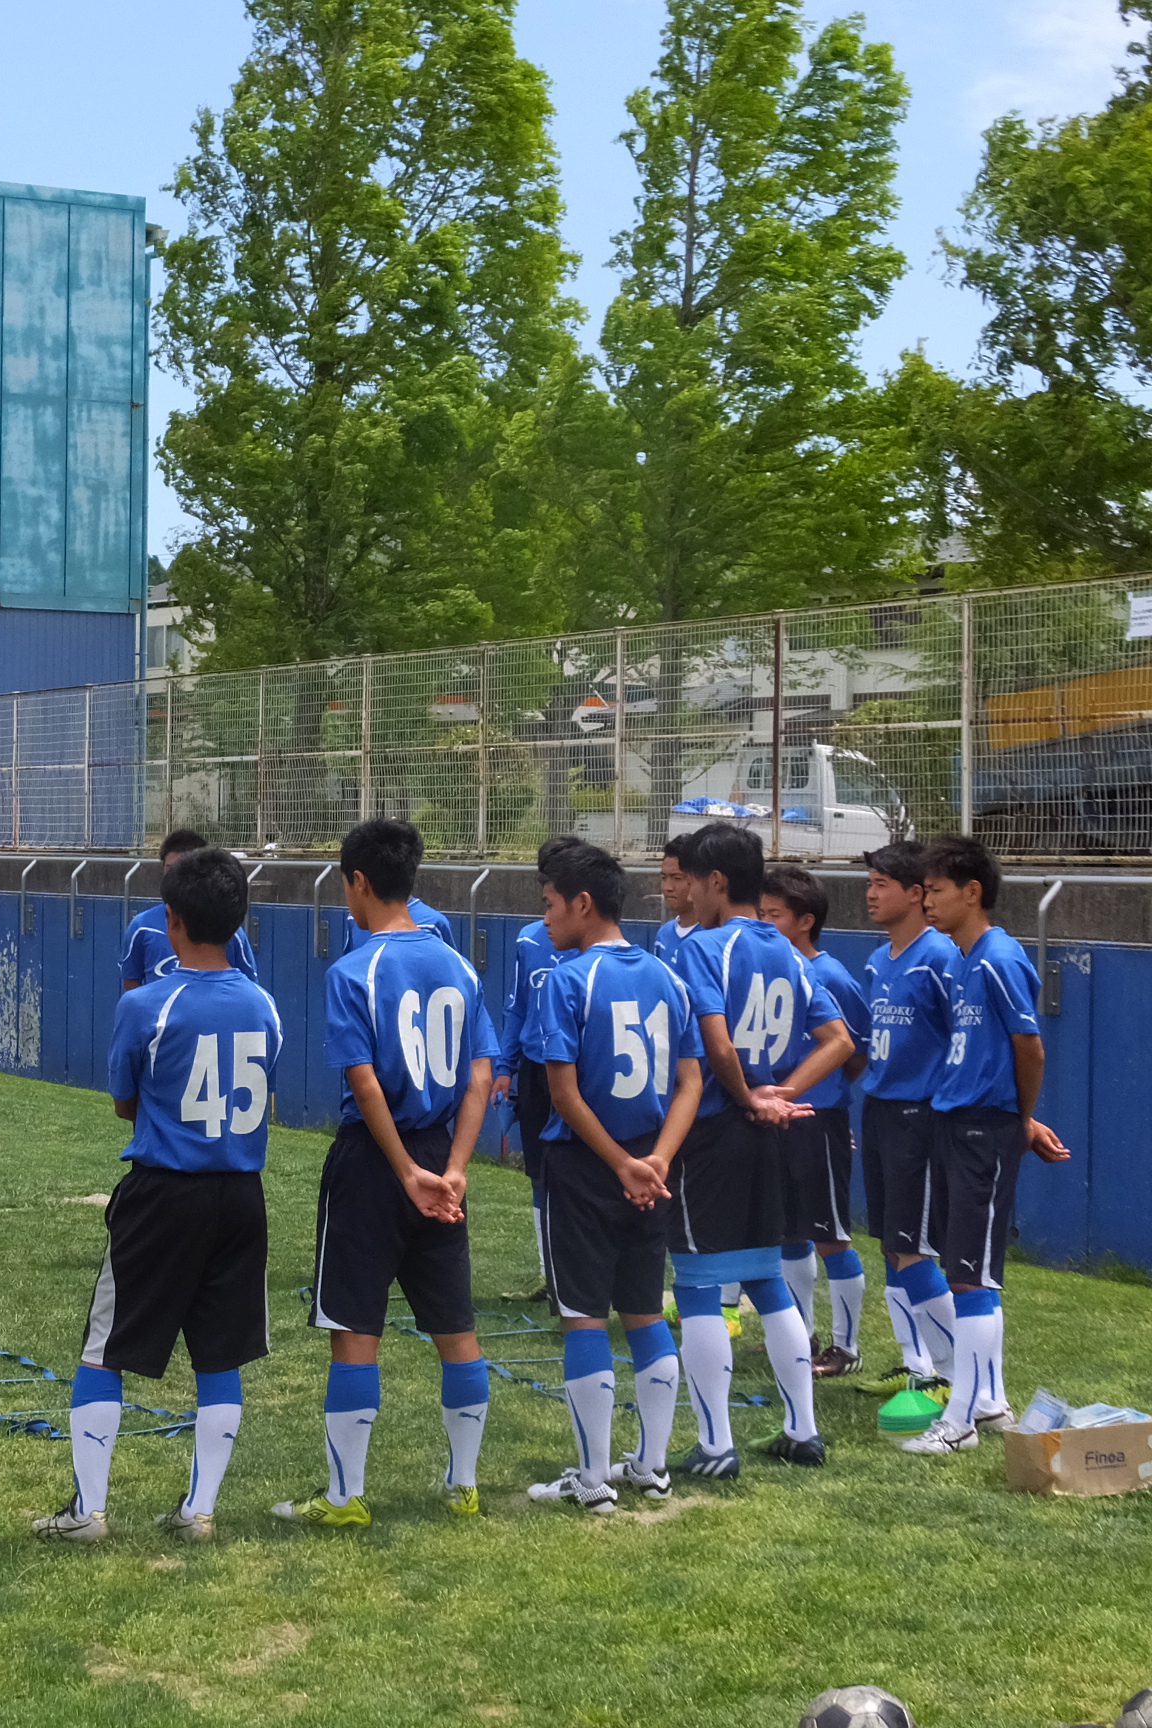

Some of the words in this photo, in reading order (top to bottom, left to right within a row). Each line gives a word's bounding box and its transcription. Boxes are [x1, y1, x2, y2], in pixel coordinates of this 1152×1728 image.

[398, 986, 465, 1090] 60
[610, 999, 670, 1098] 51
[734, 972, 794, 1066] 49
[871, 1029, 890, 1060] 50
[181, 1031, 268, 1137] 45
